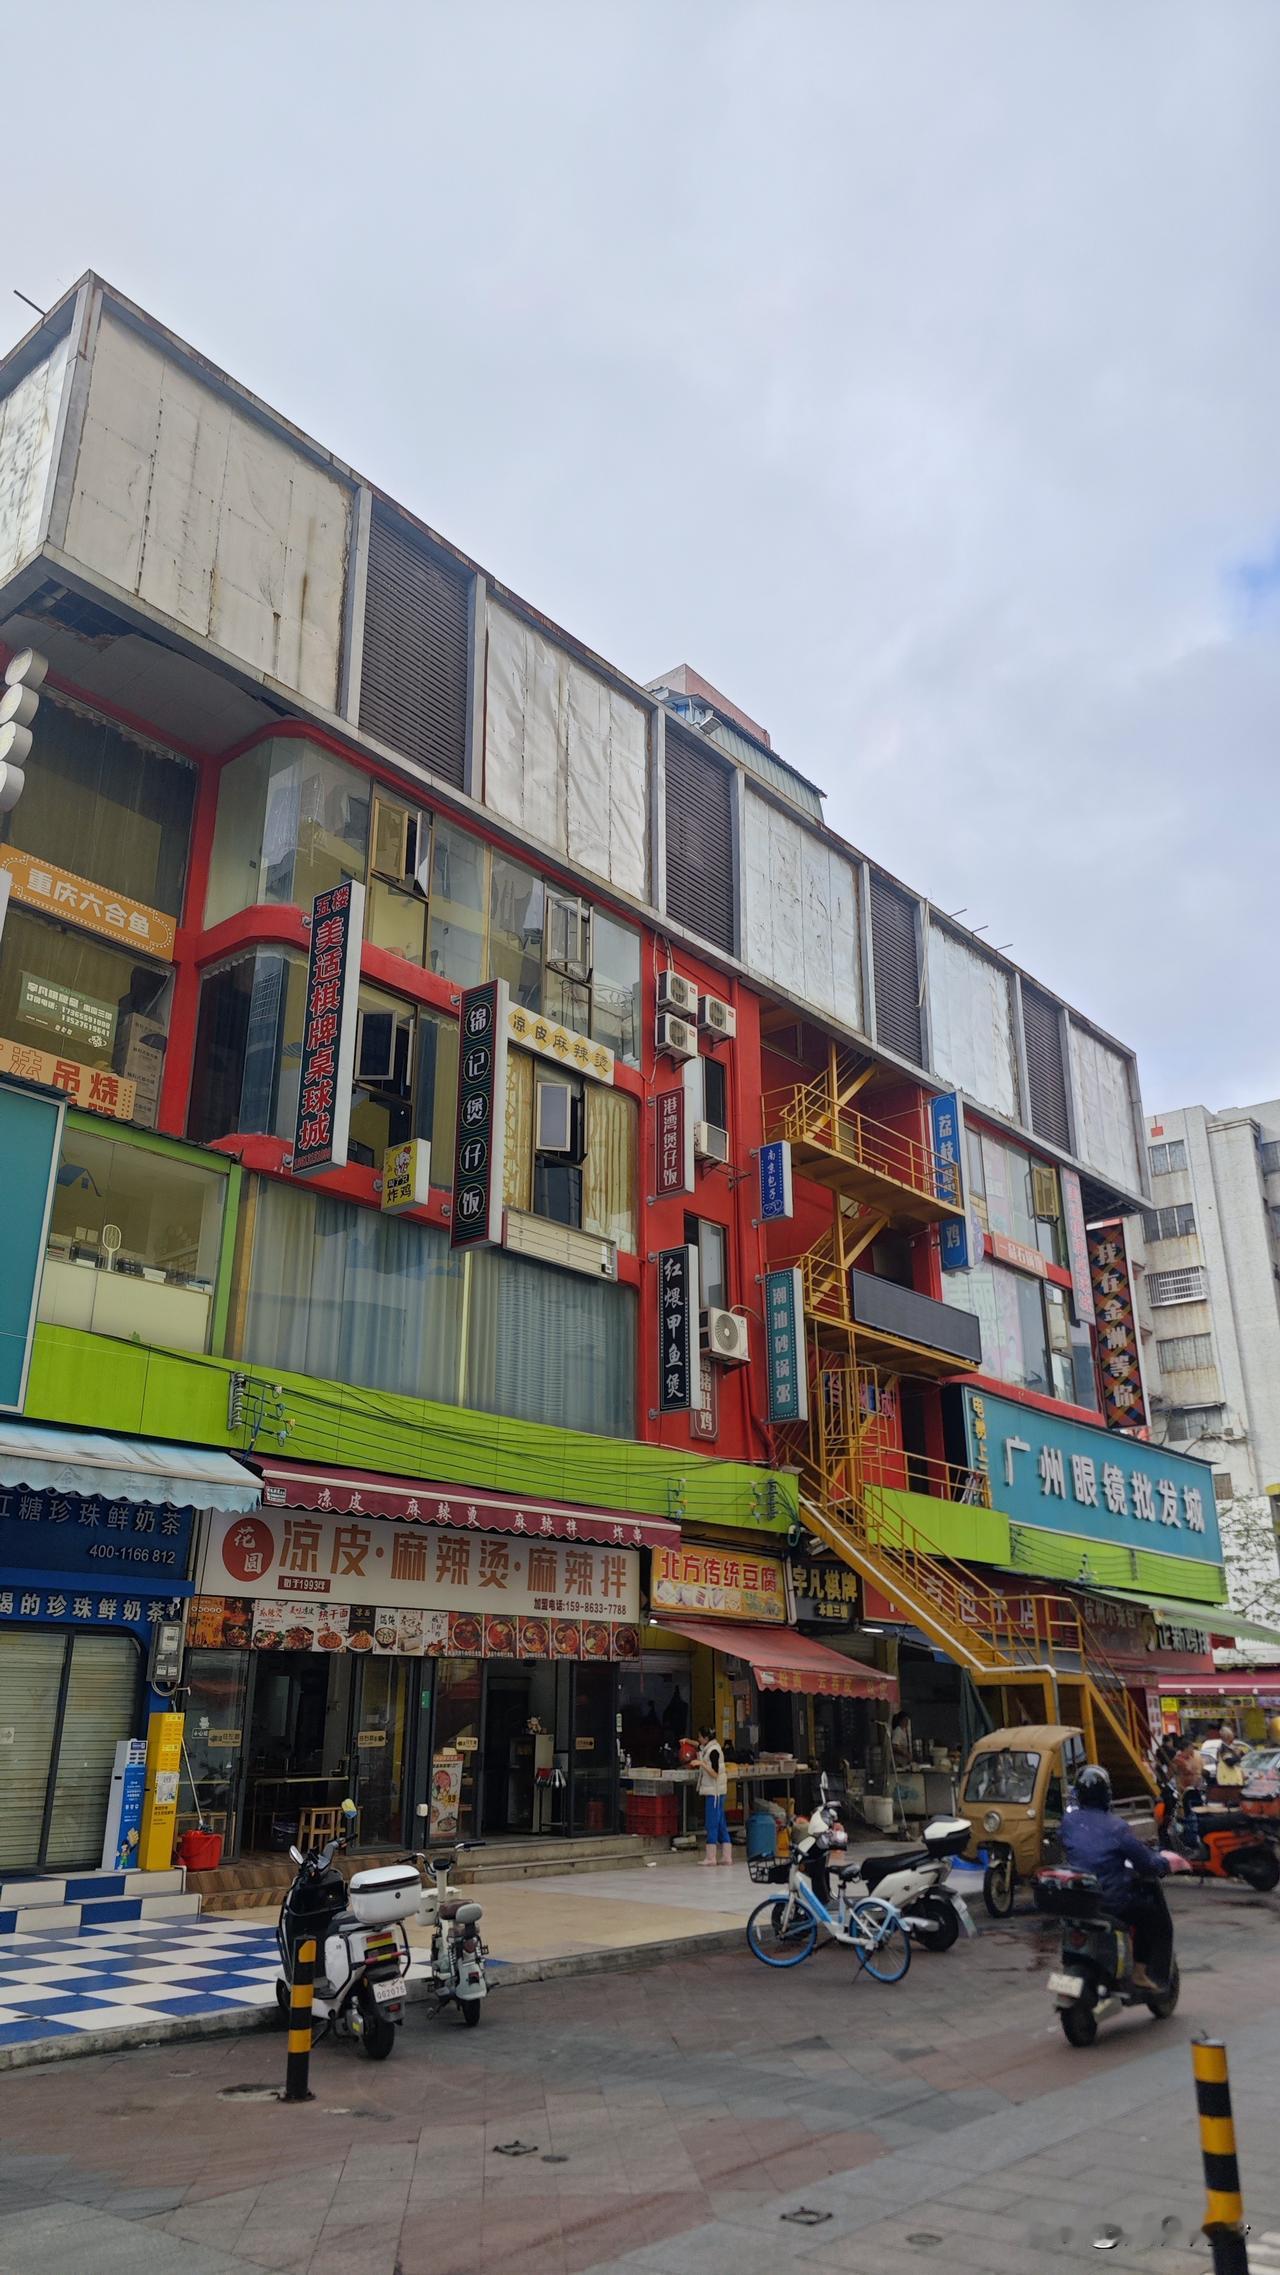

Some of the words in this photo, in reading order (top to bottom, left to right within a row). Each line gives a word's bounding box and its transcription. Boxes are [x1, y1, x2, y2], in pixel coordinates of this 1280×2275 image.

[27, 868, 150, 939] 重庆六合鱼
[315, 886, 350, 920] 五楼
[298, 916, 345, 1151] 美适棋牌桌球城
[511, 1014, 610, 1074] 凉皮麻辣烫
[460, 1007, 488, 1217] 锦记煲仔饭
[663, 1096, 678, 1187] 港湾煲仔饭
[387, 1184, 412, 1204] 炸鸡
[767, 1149, 777, 1200] 南京包子
[663, 1258, 685, 1399] 红煨甲鱼煲
[772, 1287, 791, 1404] 潮汕砂锅粥
[1005, 1436, 1205, 1533] 广州眼镜批发城
[317, 1488, 364, 1511] 凉皮
[406, 1498, 480, 1527] 麻辣烫
[513, 1511, 577, 1536] 麻辣拌
[612, 1524, 643, 1543] 炸串
[89, 1544, 149, 1562] 400-1166
[152, 1550, 176, 1564] 812
[661, 1551, 777, 1592] 北方传统豆腐
[793, 1564, 858, 1601] 宇凡棋牌
